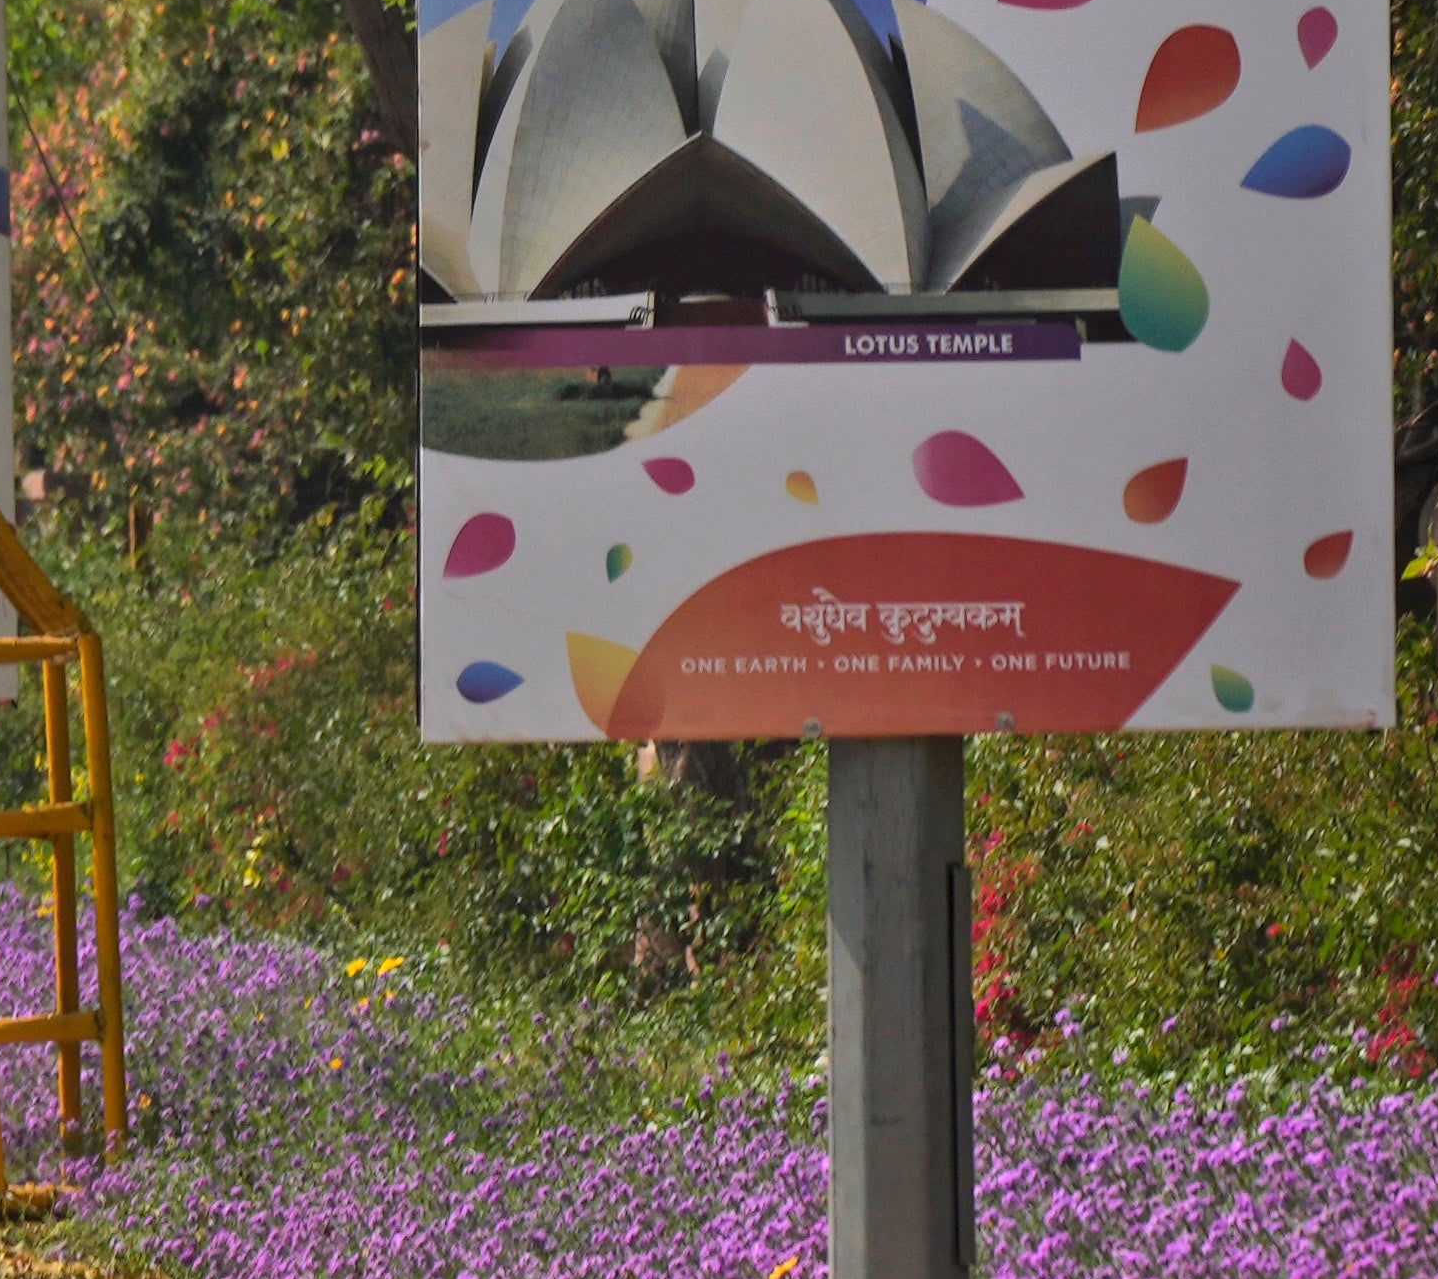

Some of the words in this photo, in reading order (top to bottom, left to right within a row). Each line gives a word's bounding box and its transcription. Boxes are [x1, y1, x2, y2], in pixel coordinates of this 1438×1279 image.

[845, 333, 920, 355] LOTUS
[926, 333, 1014, 354] TEMPLE
[680, 658, 726, 675] ONE
[735, 657, 807, 675] EARTH
[834, 656, 880, 673] ONE
[888, 655, 965, 672] FAMILY
[991, 653, 1038, 671] ONE
[1046, 652, 1131, 671] FUTURE
